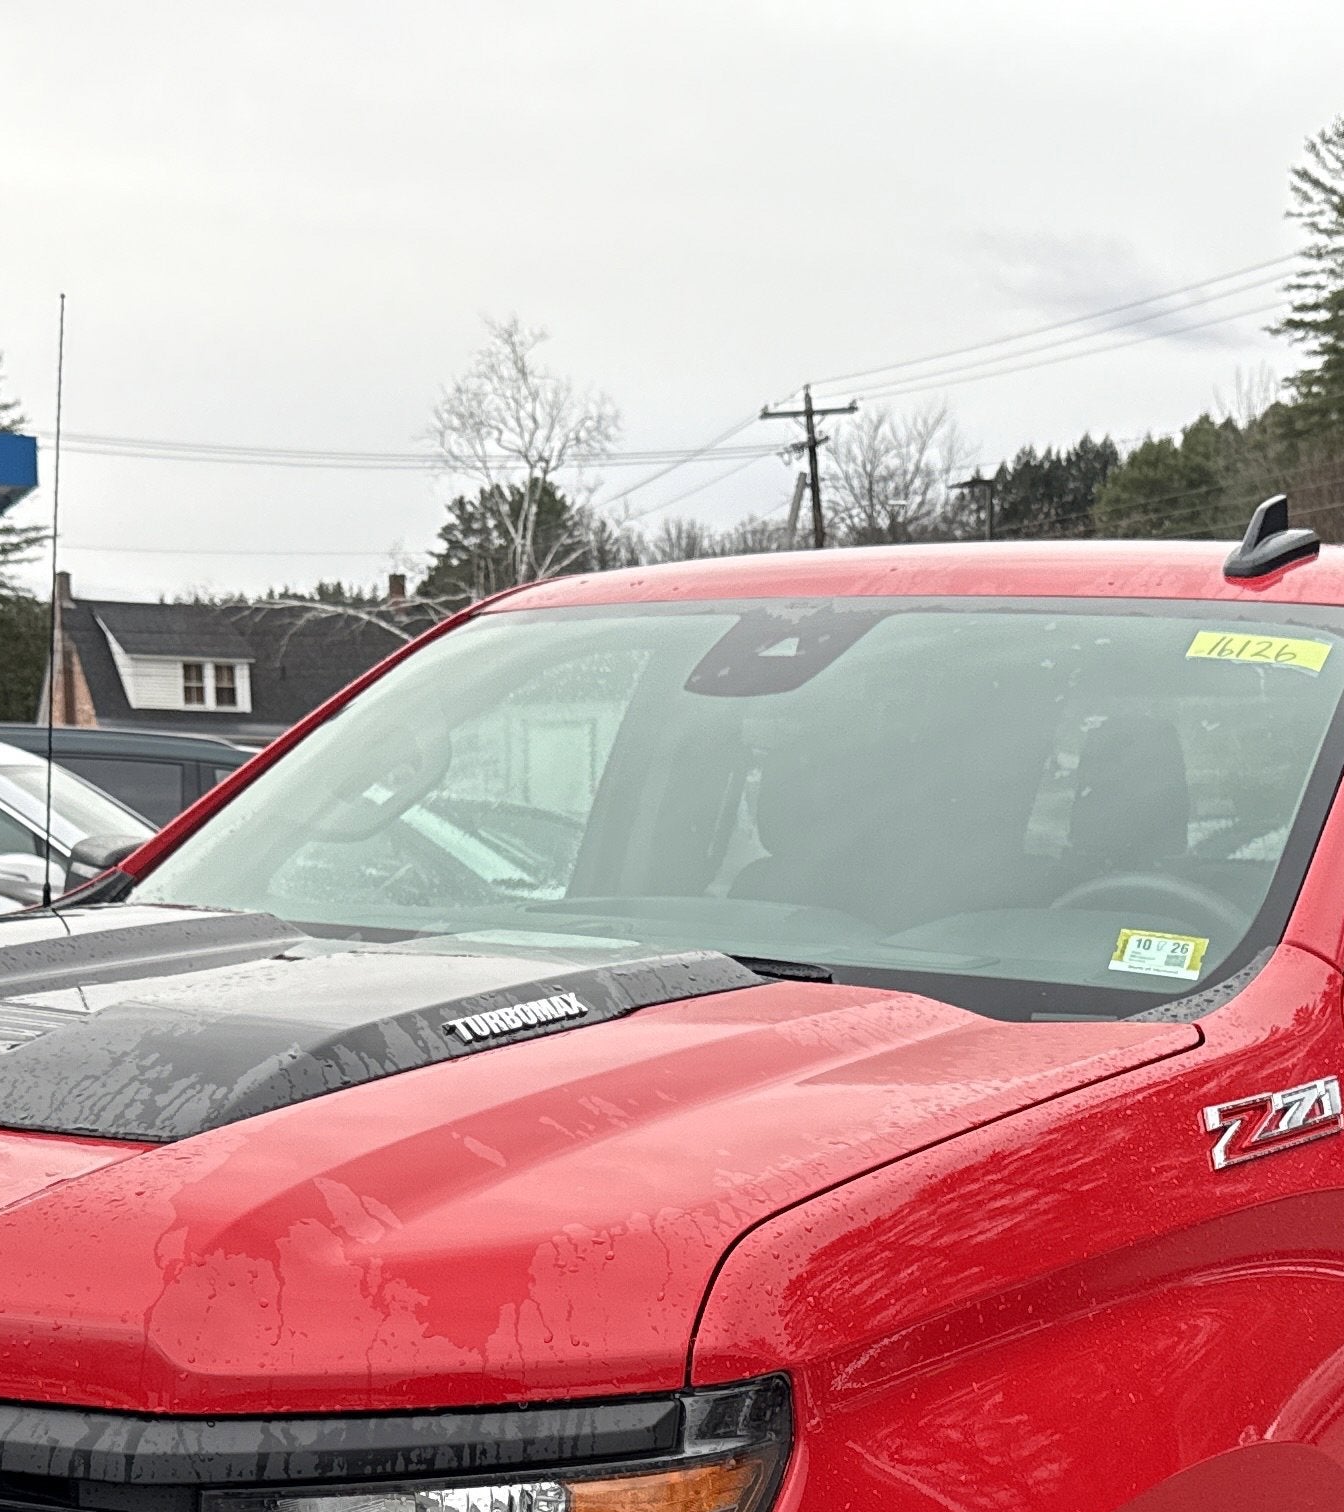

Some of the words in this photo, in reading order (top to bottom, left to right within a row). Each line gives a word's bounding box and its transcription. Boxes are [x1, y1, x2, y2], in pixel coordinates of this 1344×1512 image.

[1207, 636, 1297, 662] 16126
[1136, 938, 1152, 951] 10
[1171, 942, 1190, 955] 26
[442, 992, 589, 1043] TURBOMAX
[1198, 1075, 1344, 1171] Z71
